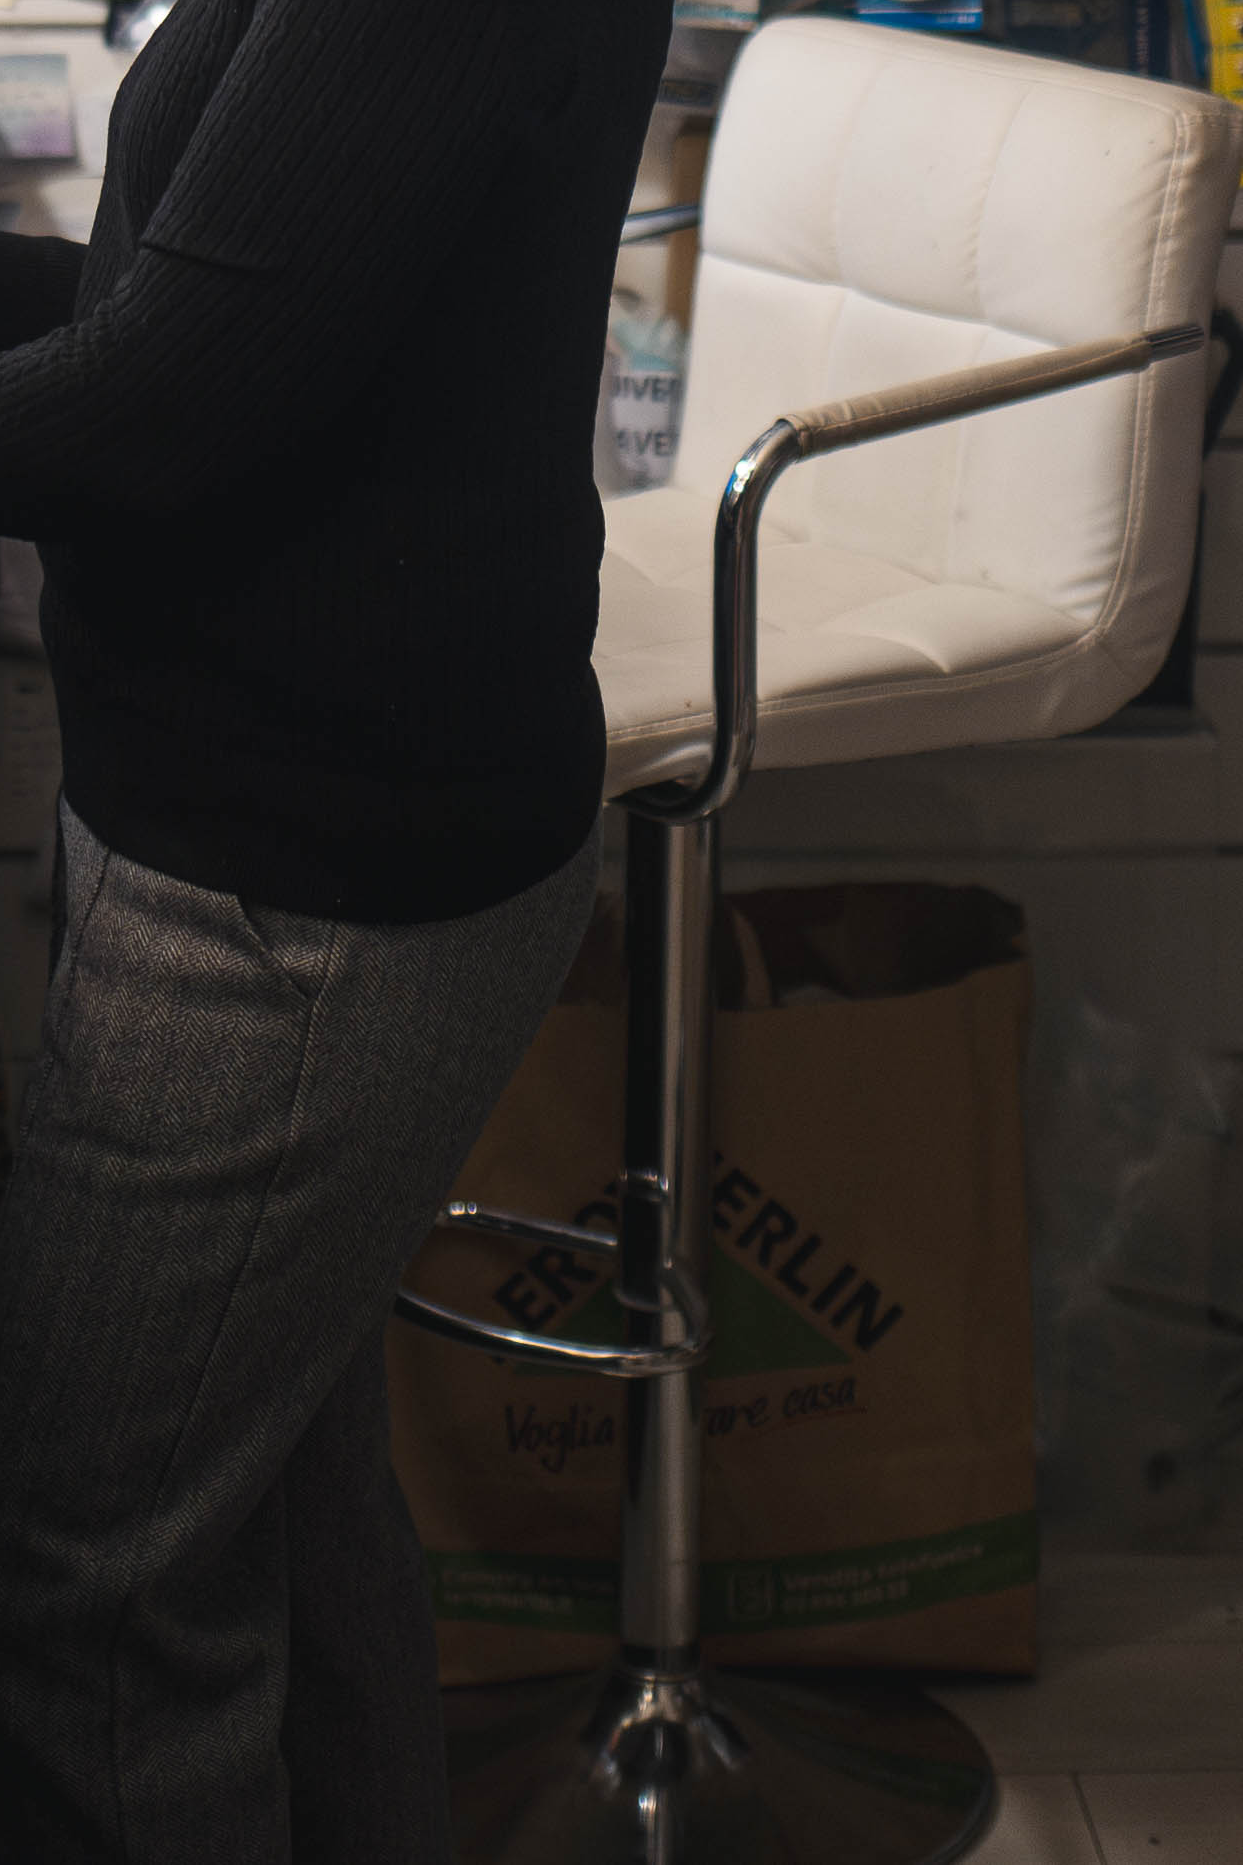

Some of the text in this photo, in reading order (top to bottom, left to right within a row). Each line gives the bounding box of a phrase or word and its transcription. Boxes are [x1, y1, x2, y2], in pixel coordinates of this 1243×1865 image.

[711, 1148, 905, 1353] ERLIN
[503, 1376, 857, 1475] Voglia are casa
